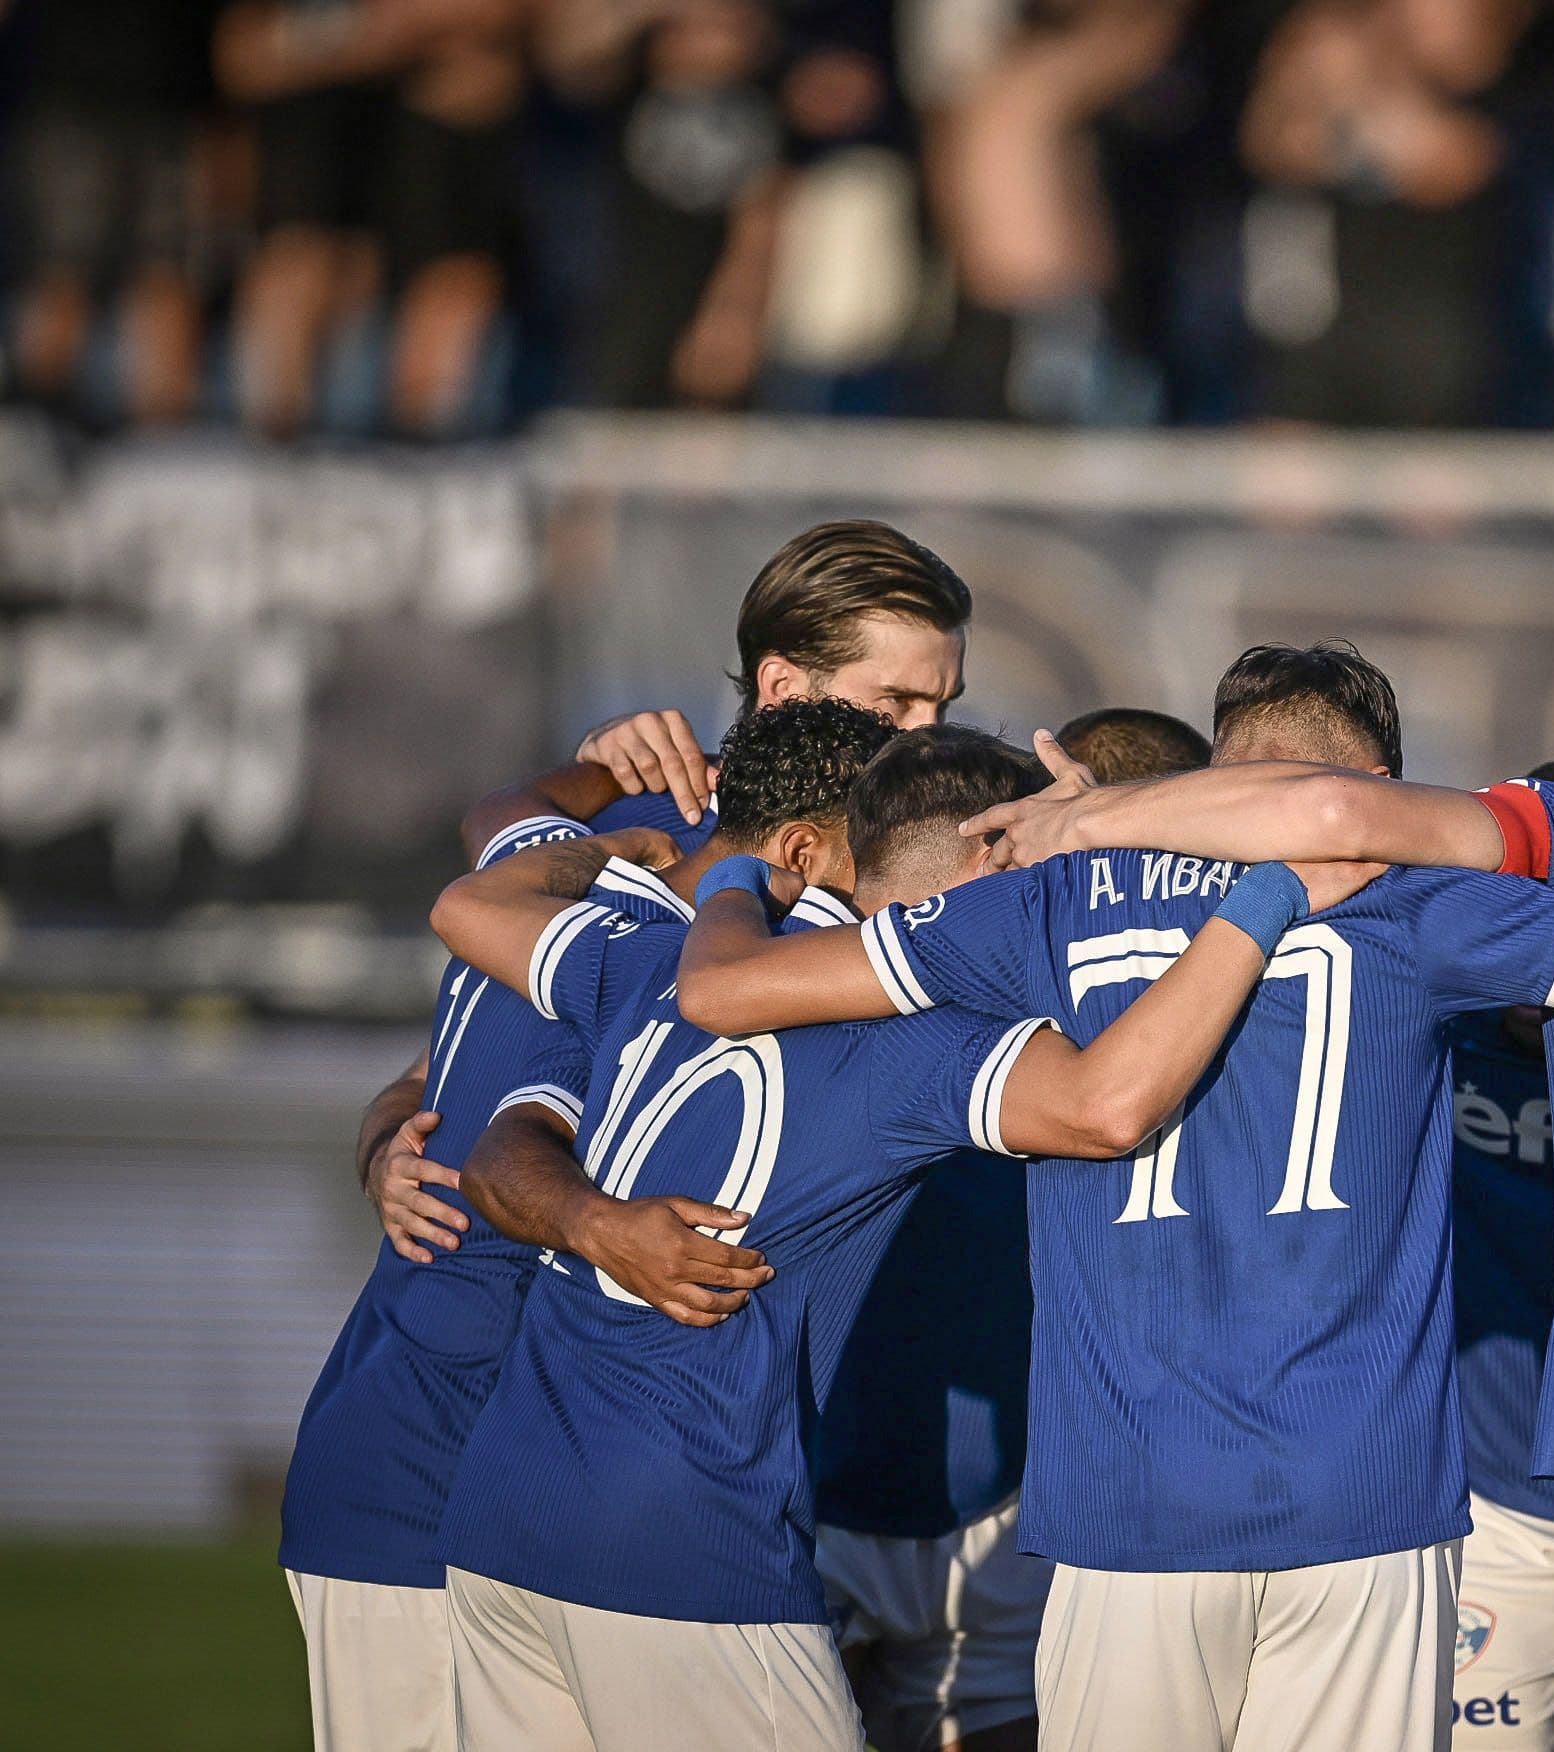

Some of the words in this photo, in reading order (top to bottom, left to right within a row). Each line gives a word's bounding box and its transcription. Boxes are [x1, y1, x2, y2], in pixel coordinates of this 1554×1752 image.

[1141, 853, 1250, 899] ИВА
[537, 1019, 785, 1308] 10
[1067, 923, 1352, 1224] 77
